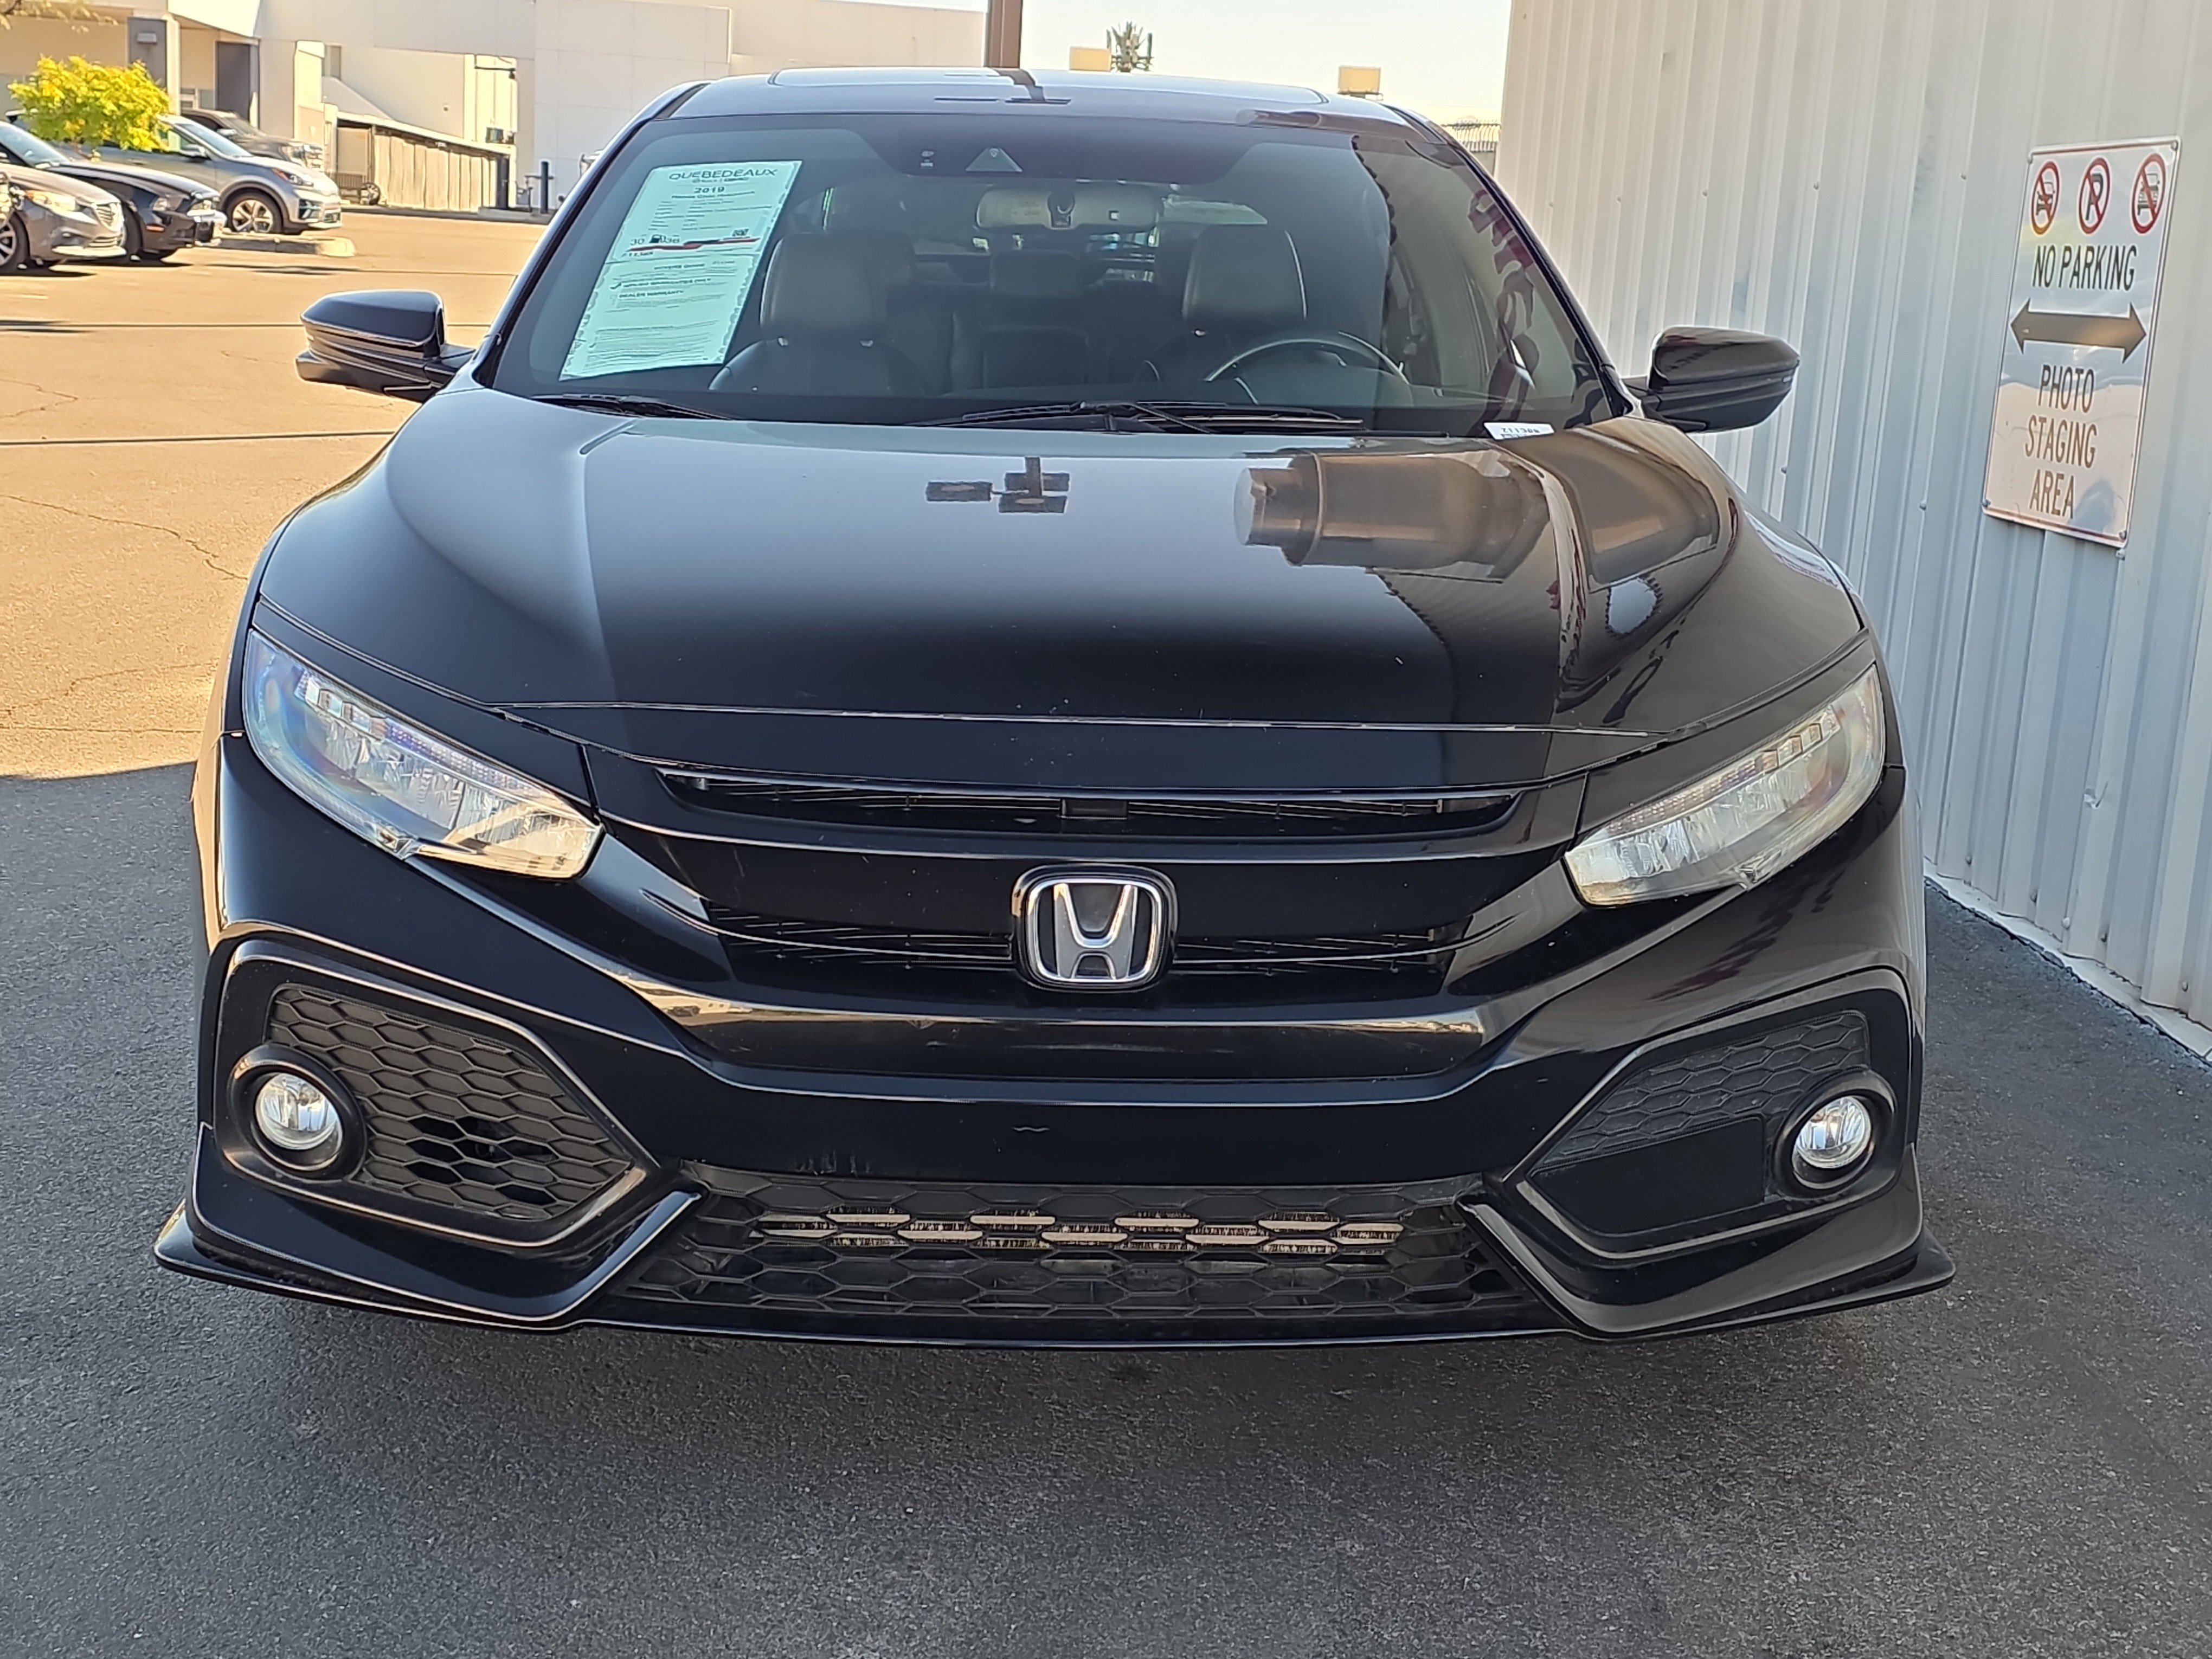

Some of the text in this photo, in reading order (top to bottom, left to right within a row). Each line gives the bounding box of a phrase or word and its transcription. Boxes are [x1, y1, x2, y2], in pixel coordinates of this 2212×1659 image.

[669, 169, 778, 180] QUEBEDEAUX
[2033, 245, 2137, 291] NO PARKING
[2039, 364, 2094, 413] PHOTO
[2025, 415, 2097, 468] STAGING
[2029, 469, 2074, 519] AREA
